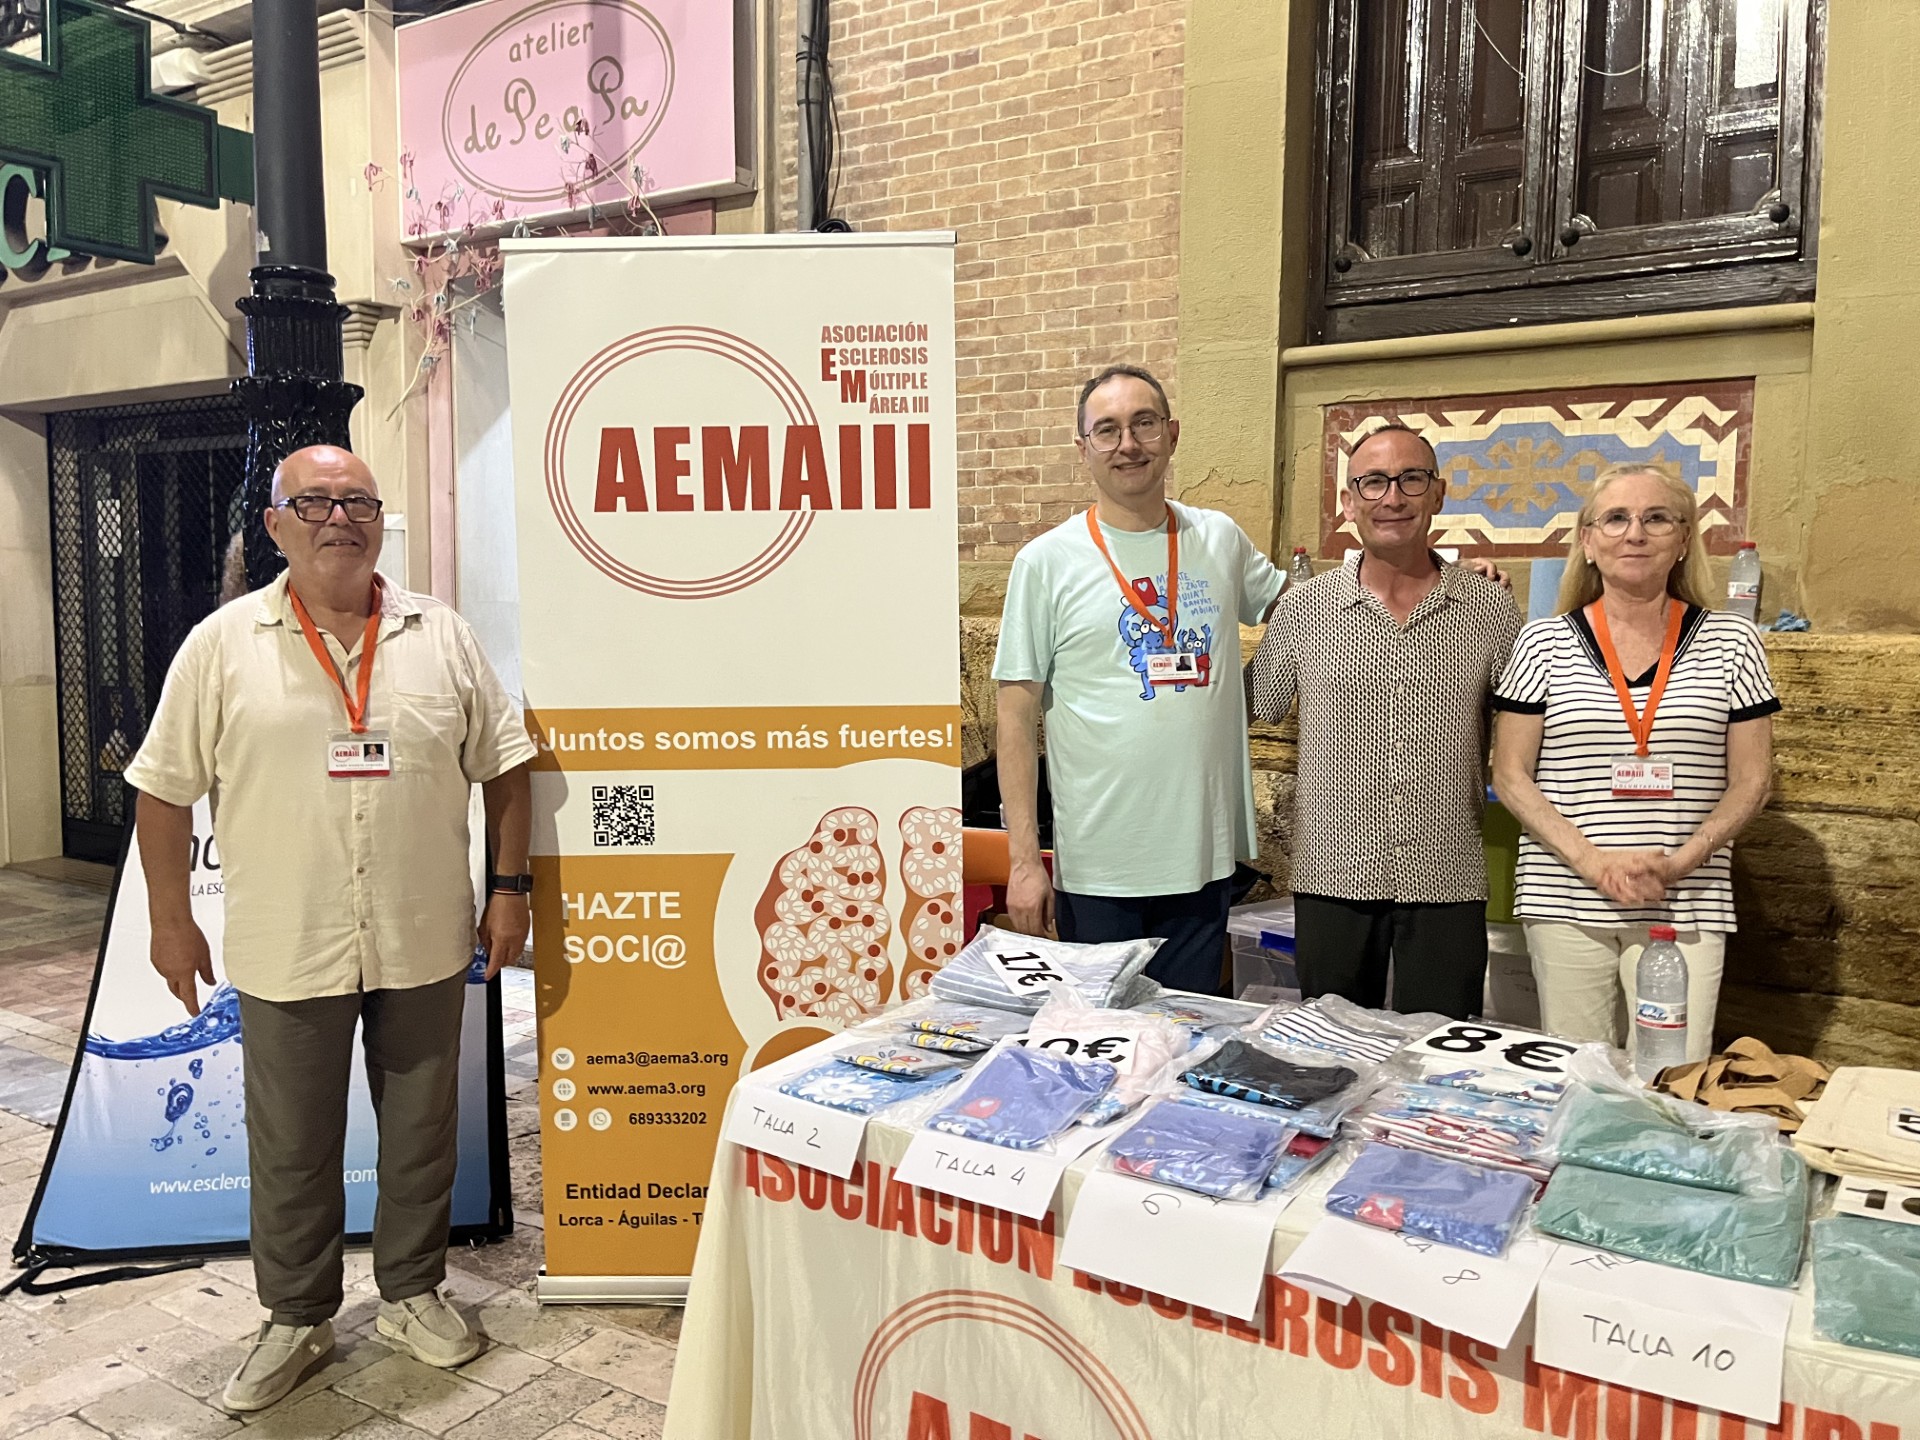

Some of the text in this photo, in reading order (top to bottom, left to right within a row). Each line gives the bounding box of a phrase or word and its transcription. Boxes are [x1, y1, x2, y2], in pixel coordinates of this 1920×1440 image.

[508, 22, 595, 62] atelier
[463, 104, 502, 154] de
[503, 77, 554, 145] Pe
[587, 55, 649, 126] Pa
[821, 321, 928, 343] ASOCIACIÓN
[869, 393, 929, 414] ÁREA III
[594, 424, 931, 512] AEMAIII
[655, 730, 756, 751] somos
[767, 723, 829, 750] más
[839, 723, 953, 749] fuertes!
[191, 884, 205, 896] LA
[561, 891, 682, 920] HAZTE
[563, 934, 687, 969] SOCI@
[586, 1051, 729, 1068] aema3@aema3.org
[587, 1082, 706, 1098] www.aema3.org
[628, 1111, 708, 1126] 689333202
[753, 1106, 822, 1149] TALLA 2
[935, 1150, 1026, 1186] TALLA 4
[565, 1183, 641, 1200] Entidad
[558, 1213, 604, 1227] Lorca
[618, 1210, 678, 1229] Águilas
[1583, 1314, 1736, 1372] TALLA 10
